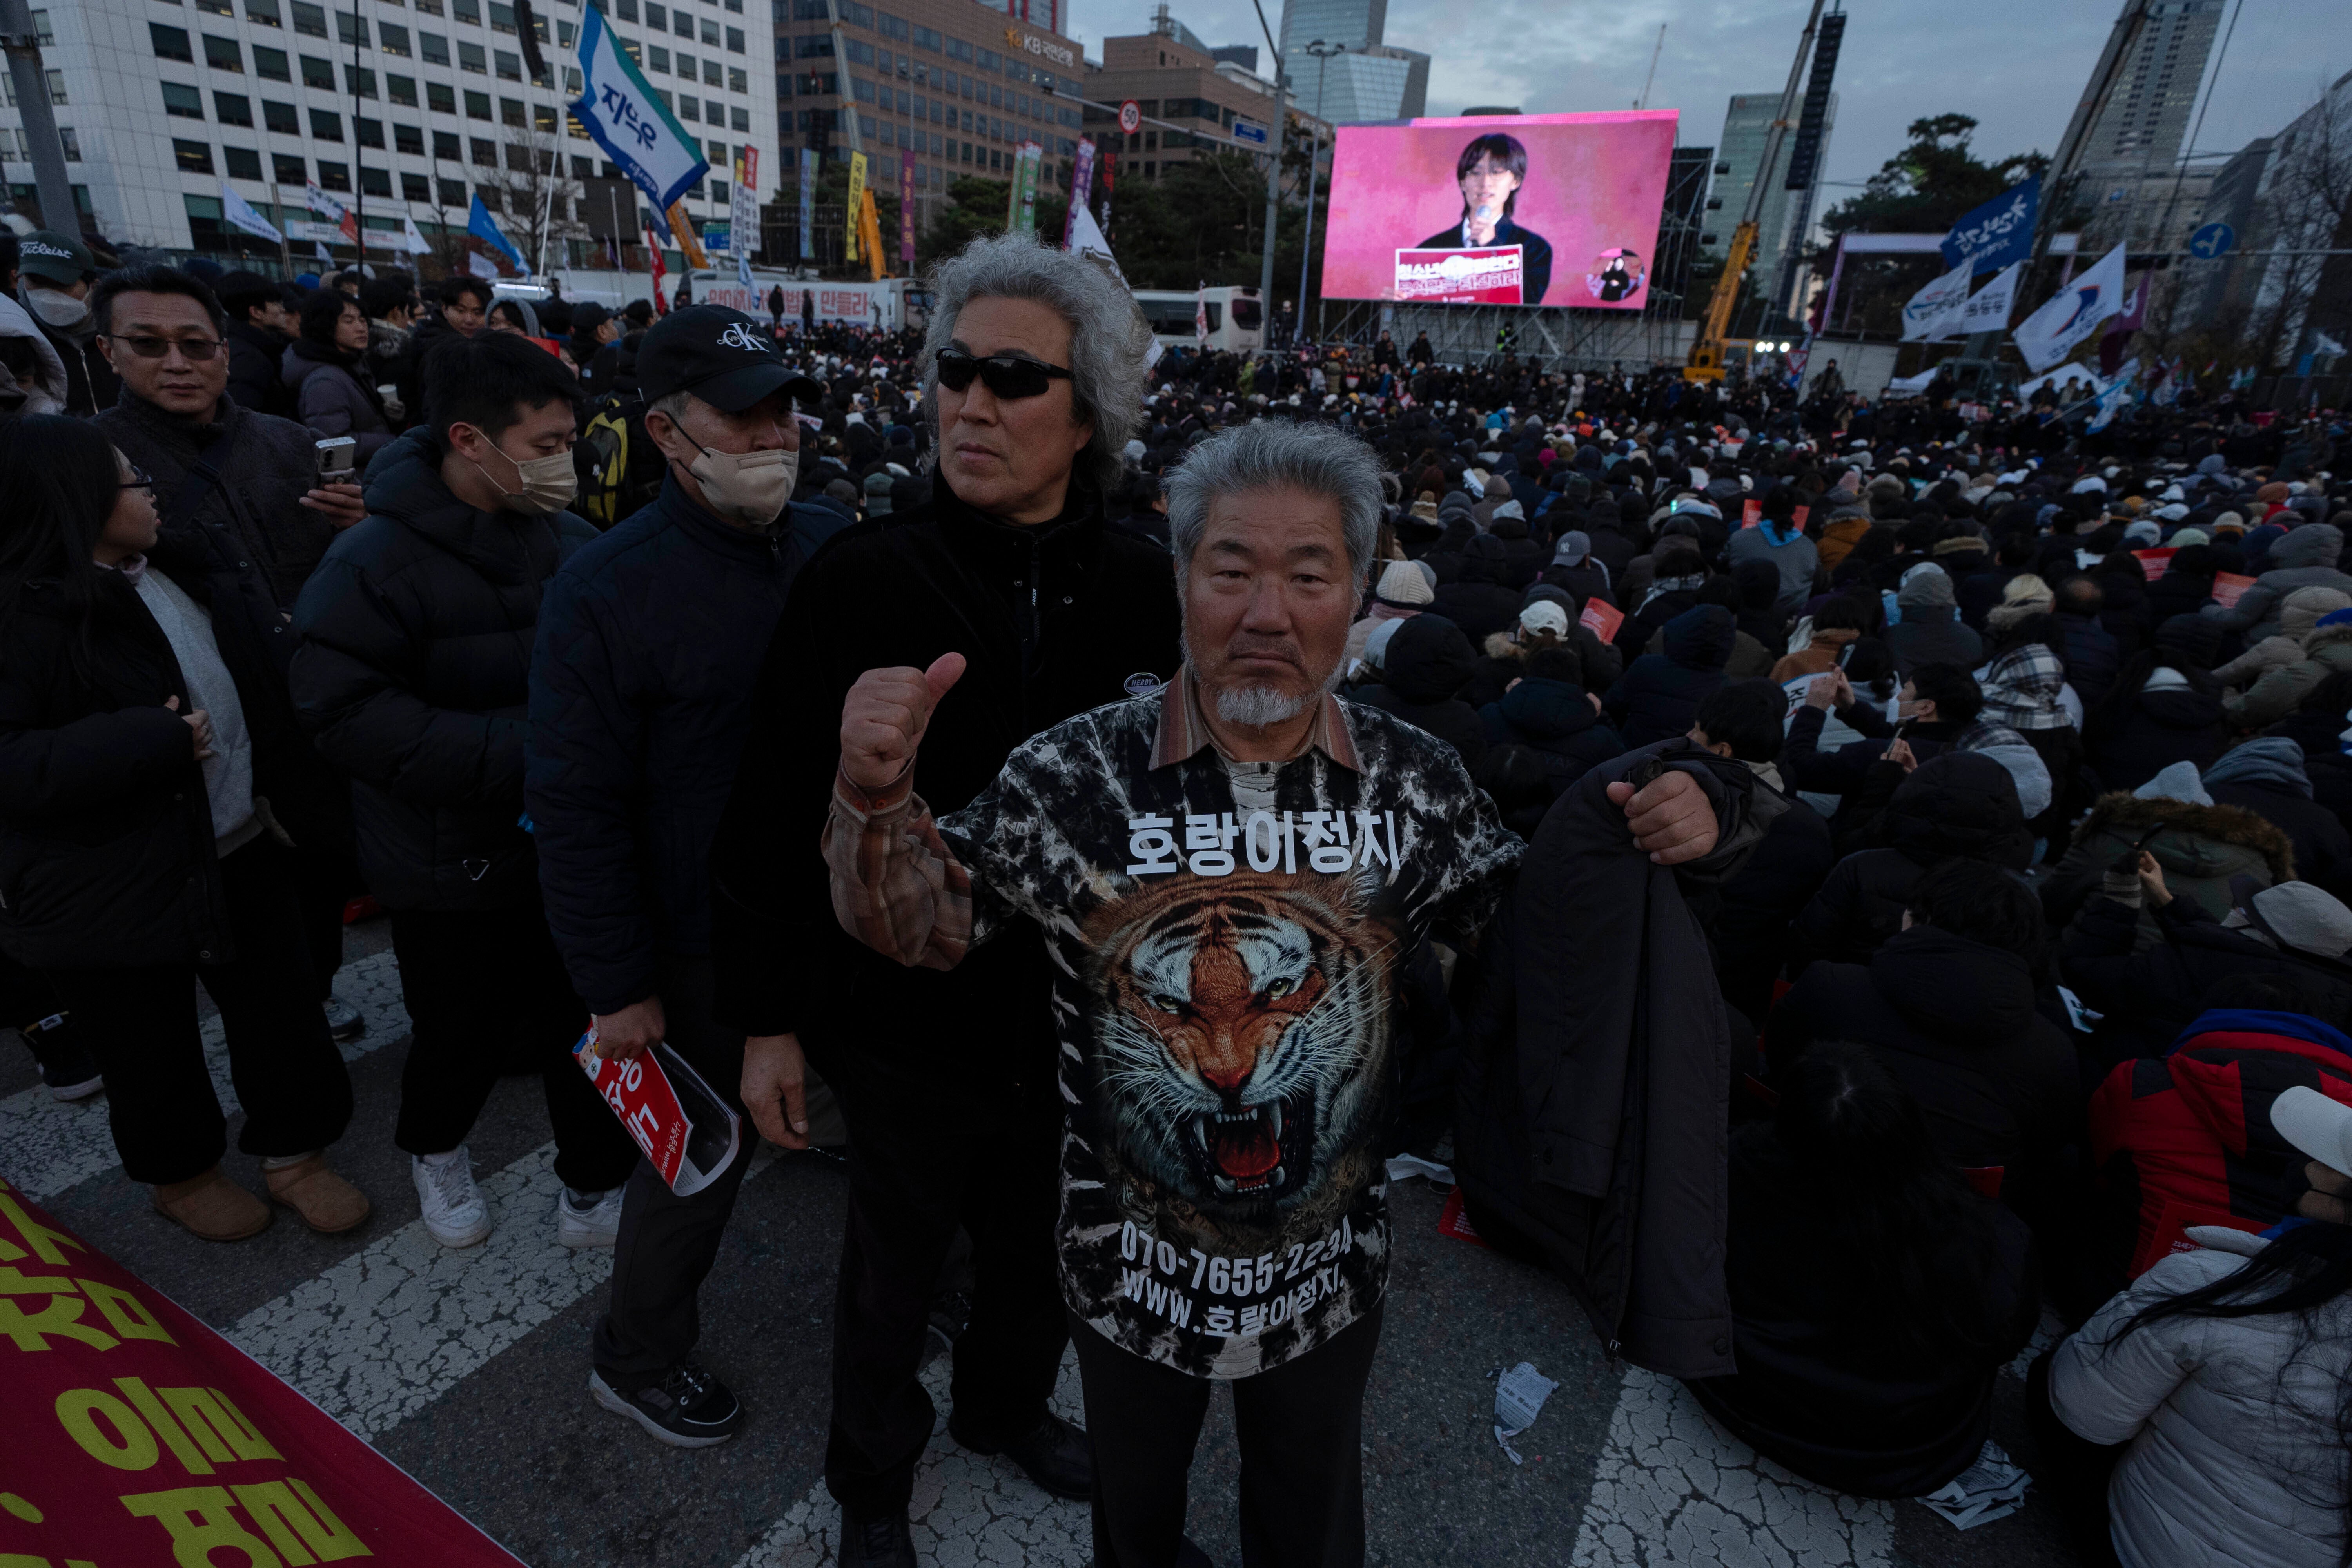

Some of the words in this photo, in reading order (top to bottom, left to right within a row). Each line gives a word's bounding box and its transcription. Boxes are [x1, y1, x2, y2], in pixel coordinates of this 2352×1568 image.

[1125, 110, 1136, 124] 50
[20, 241, 73, 259] Titleist
[1131, 678, 1154, 686] NERDY
[1126, 810, 1401, 876] 호랑이정치
[1121, 1214, 1352, 1297] 070-7655-2234
